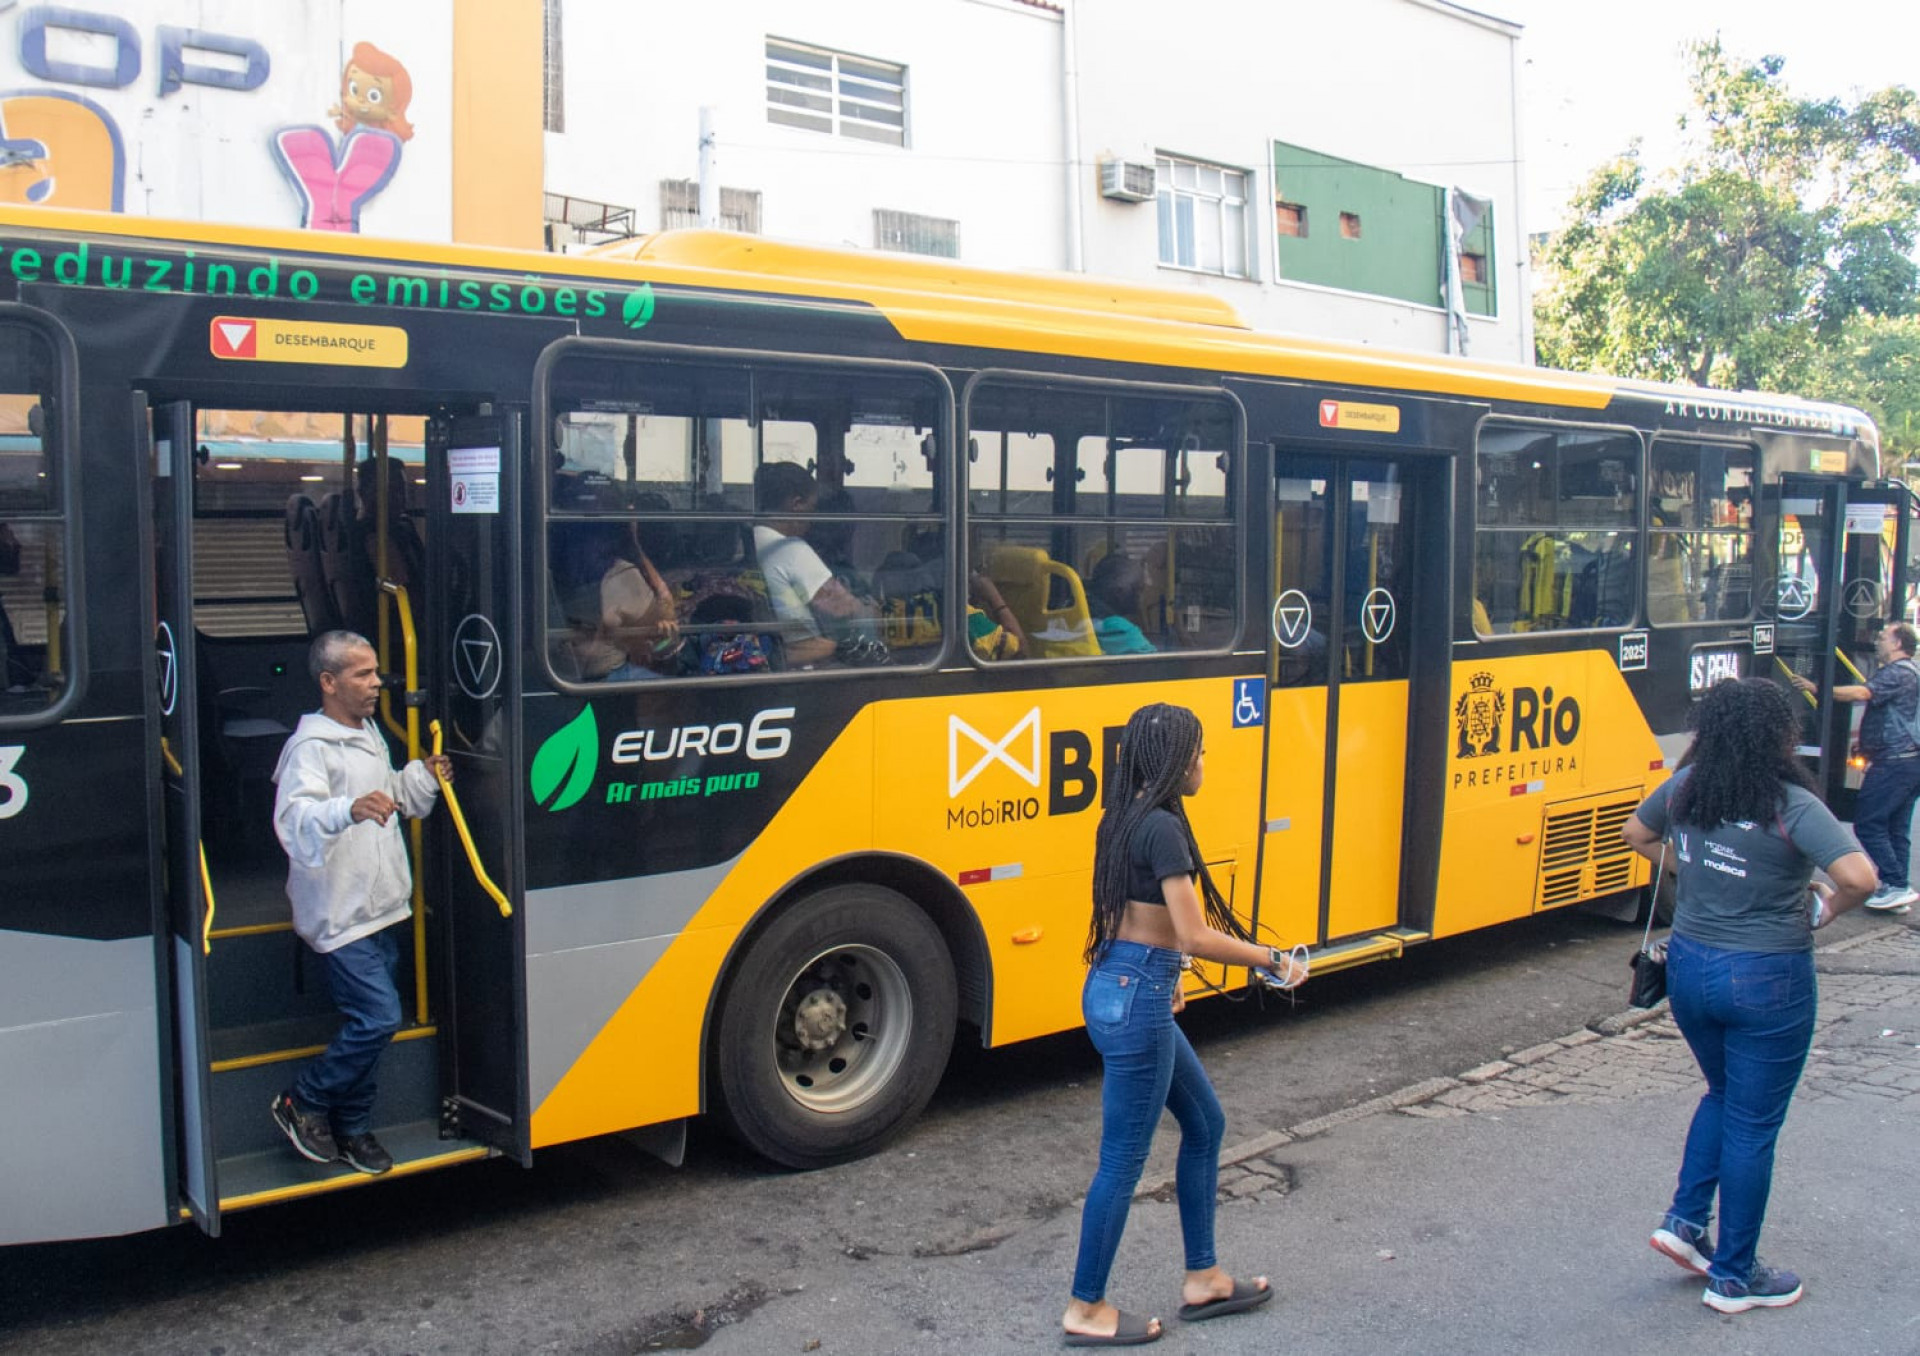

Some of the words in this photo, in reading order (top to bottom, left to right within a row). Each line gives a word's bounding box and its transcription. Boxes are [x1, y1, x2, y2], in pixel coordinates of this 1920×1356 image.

[0, 0, 270, 98] OP
[0, 242, 319, 300] eduzindo
[351, 269, 606, 317] emissões
[275, 333, 376, 352] DESEMBARQUE
[1664, 400, 1688, 417] AR
[1622, 645, 1645, 661] 2025
[1510, 686, 1581, 753] Rio
[606, 782, 637, 804] Ar
[640, 775, 701, 800] mais
[704, 771, 760, 797] puro
[1454, 756, 1577, 789] PREFEITURA
[947, 797, 1040, 830] MobiRIO
